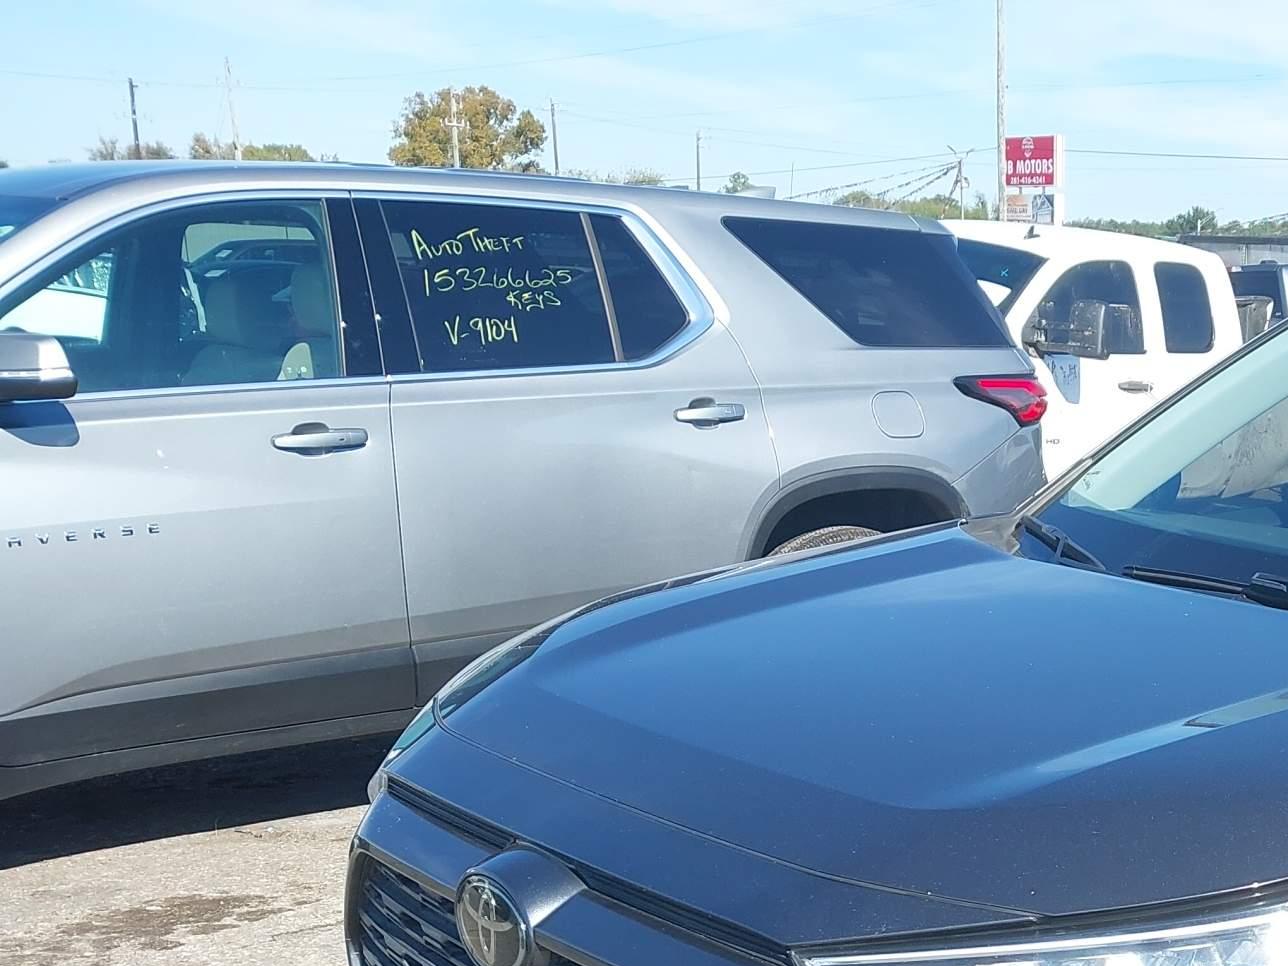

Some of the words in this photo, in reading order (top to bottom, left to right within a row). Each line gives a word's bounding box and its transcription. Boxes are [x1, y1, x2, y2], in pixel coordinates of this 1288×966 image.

[1016, 158, 1053, 174] MOTORS
[425, 267, 573, 296] 153266625
[444, 316, 519, 345] V-9104
[7, 523, 161, 548] AVERSE
